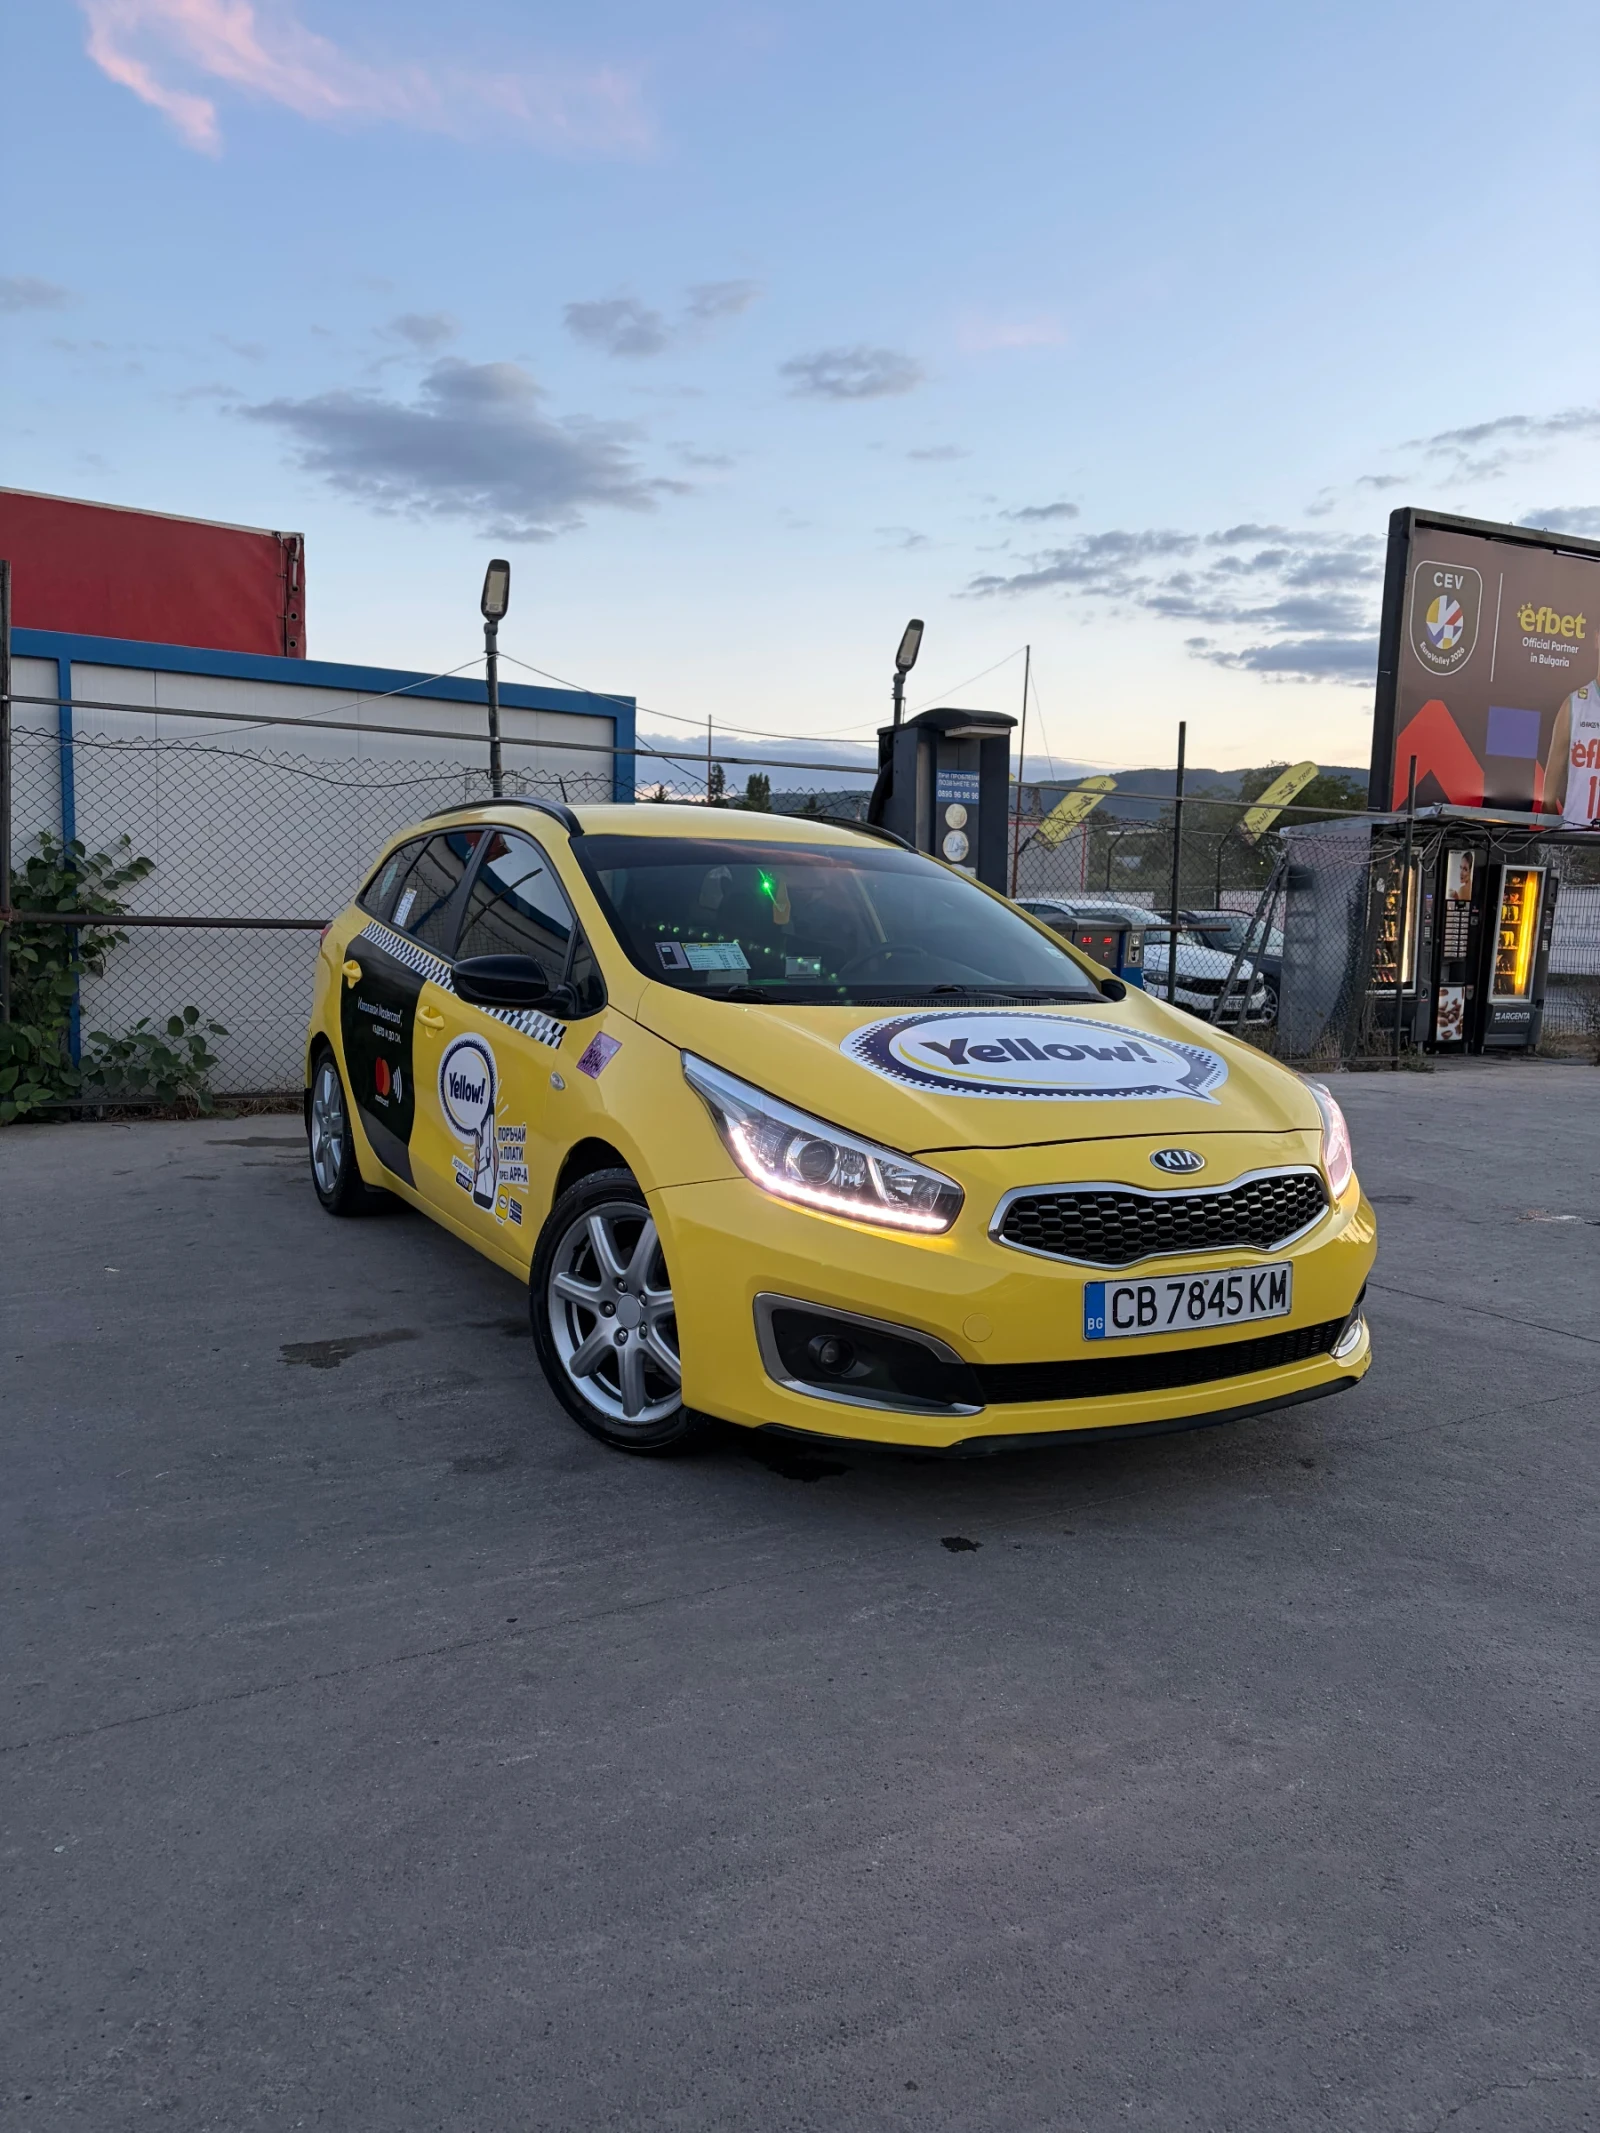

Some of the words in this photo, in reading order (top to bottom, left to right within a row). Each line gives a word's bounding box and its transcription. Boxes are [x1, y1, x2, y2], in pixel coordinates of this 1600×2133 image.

[1433, 572, 1464, 590] CEV
[1520, 606, 1587, 639] efbet
[1420, 641, 1450, 667] EuroVolley
[1522, 637, 1551, 650] Official
[1551, 641, 1580, 654] Partner
[1530, 652, 1538, 663] in
[1539, 654, 1570, 668] Bulgaria
[938, 772, 950, 780] ПРИ
[1501, 1012, 1530, 1020] ARGENTA
[919, 1036, 1159, 1066] Yellow!
[449, 1071, 486, 1105] Yellow!
[498, 1123, 527, 1143] ПОРЪЧАЙ
[503, 1146, 524, 1162] ПЛАТИ
[1161, 1151, 1201, 1167] KIA
[1112, 1287, 1158, 1328] CB
[1166, 1276, 1244, 1324] 7845
[1250, 1269, 1288, 1313] KM
[1087, 1317, 1104, 1331] BG
